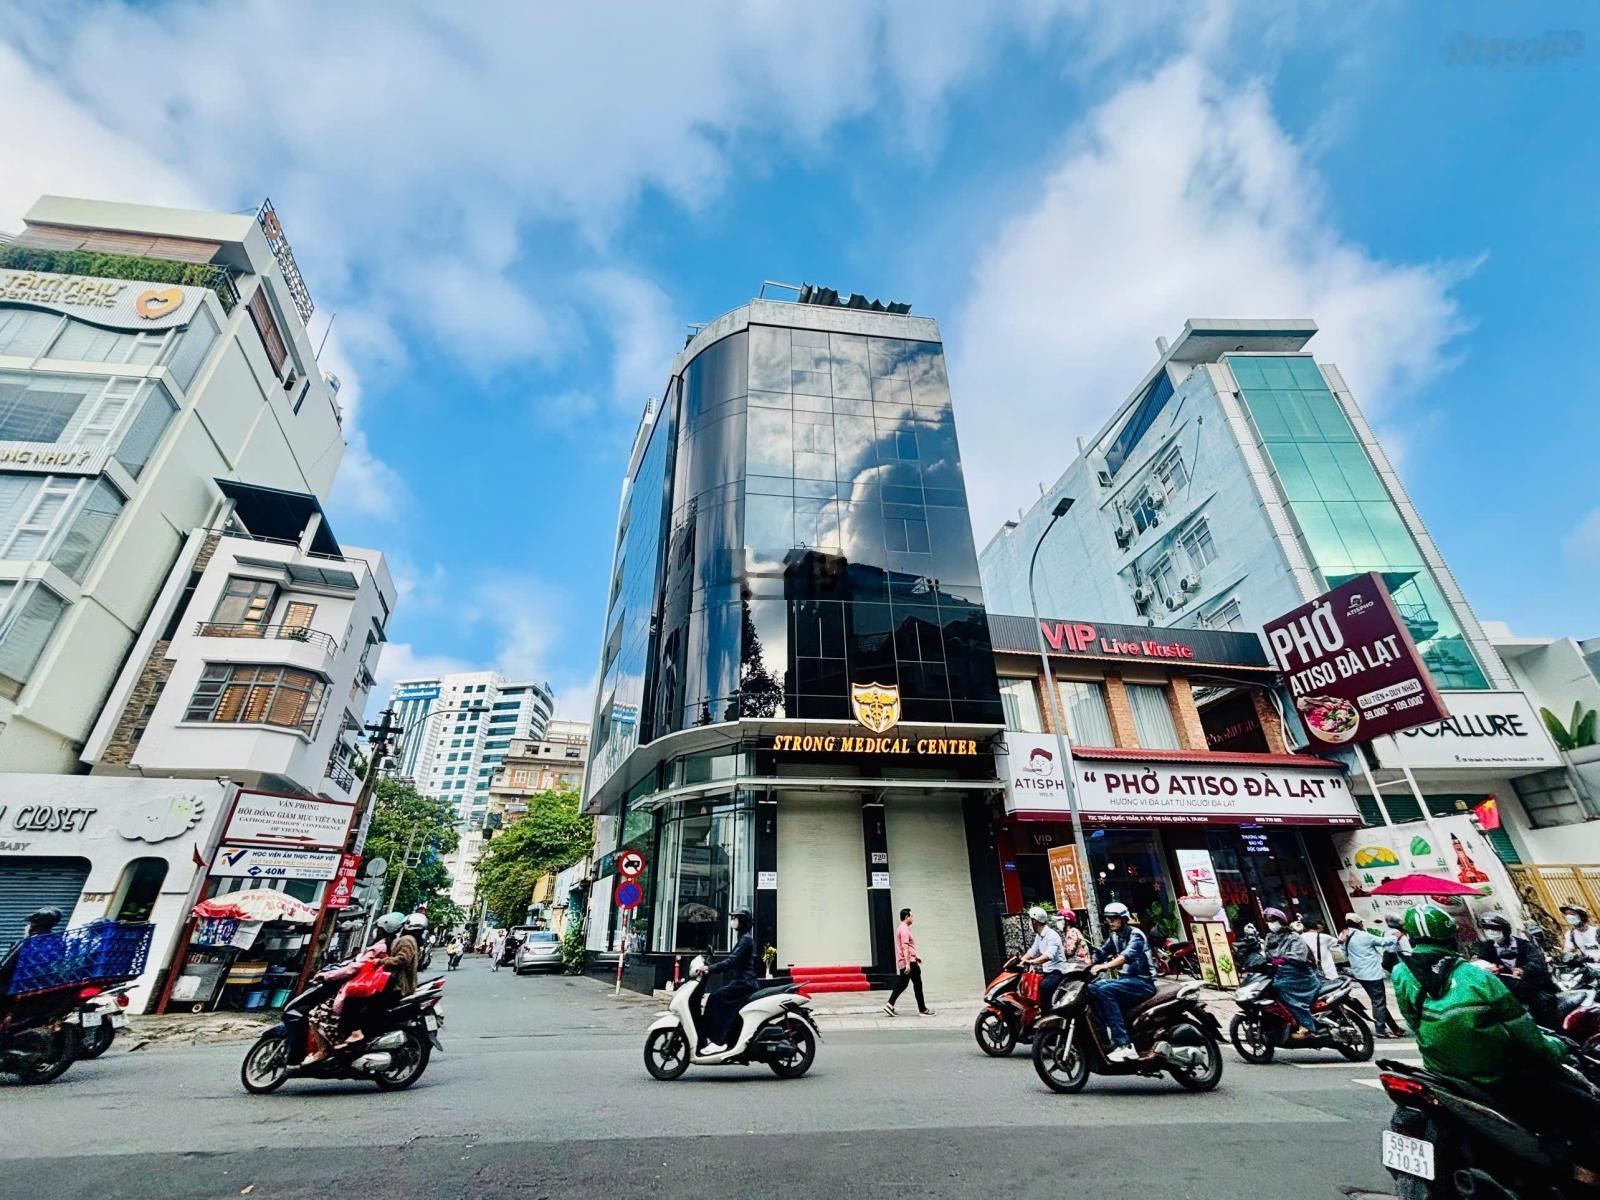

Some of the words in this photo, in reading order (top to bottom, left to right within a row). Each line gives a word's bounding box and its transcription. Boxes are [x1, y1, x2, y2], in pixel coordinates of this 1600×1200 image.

[1346, 601, 1375, 617] ATISPHO
[1040, 622, 1097, 651] VIP
[1101, 637, 1141, 655] Live
[1141, 641, 1193, 658] Music
[1269, 600, 1344, 672] PHỞ
[1289, 662, 1337, 697] ATISO
[1334, 648, 1366, 679] ĐÀ
[1361, 634, 1402, 668] LẠT
[773, 735, 835, 752] STRONG
[841, 736, 910, 753] MEDICAL
[917, 739, 977, 755] CENTER
[1015, 778, 1074, 791] ATISPH
[1104, 766, 1160, 795] PHỞ
[1169, 775, 1238, 797] ATISO
[1243, 772, 1282, 798] ĐÀ
[1283, 778, 1326, 803] LẠT
[13, 805, 98, 832] CLOSET
[265, 868, 286, 876] 40M
[1053, 863, 1075, 882] VIP
[1385, 899, 1413, 907] ATISPHO
[1390, 1135, 1425, 1158] 59-PA
[1388, 1150, 1428, 1176] 210.31
